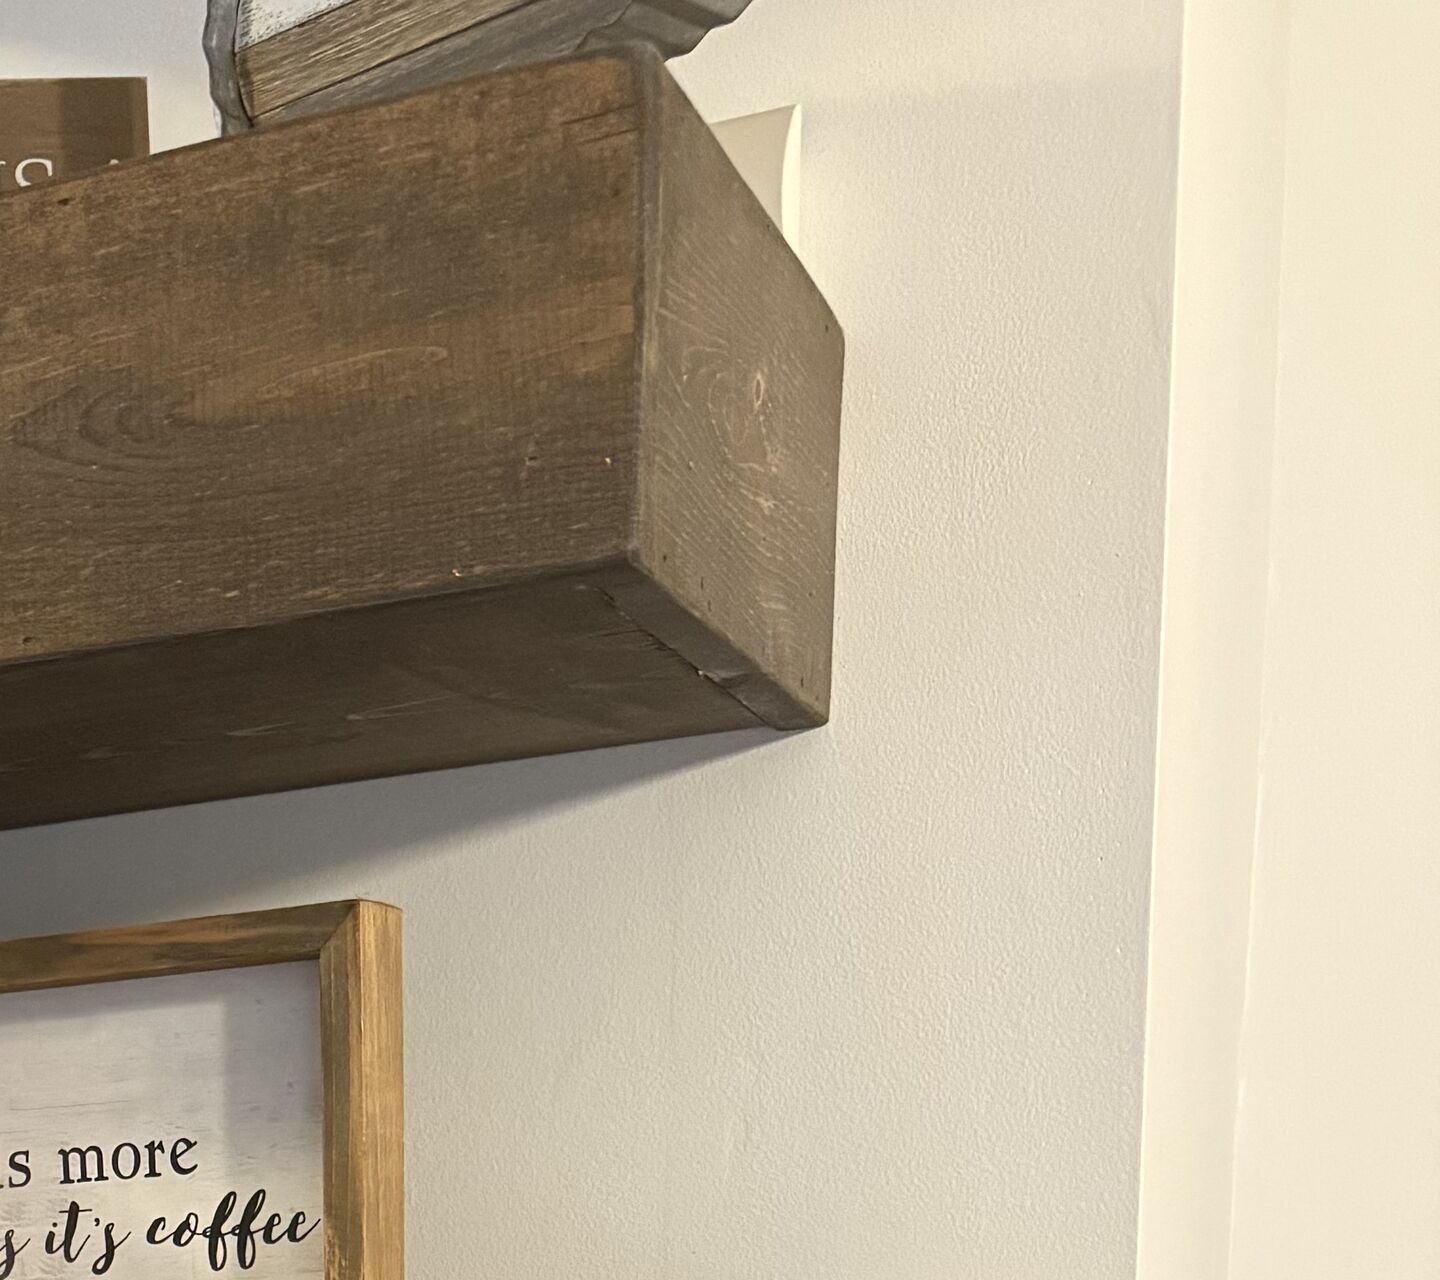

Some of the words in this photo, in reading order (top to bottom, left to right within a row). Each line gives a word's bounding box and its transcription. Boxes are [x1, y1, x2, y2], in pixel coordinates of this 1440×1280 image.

[59, 1136, 199, 1185] more
[43, 1200, 132, 1275] it's
[145, 1188, 322, 1272] coffee
